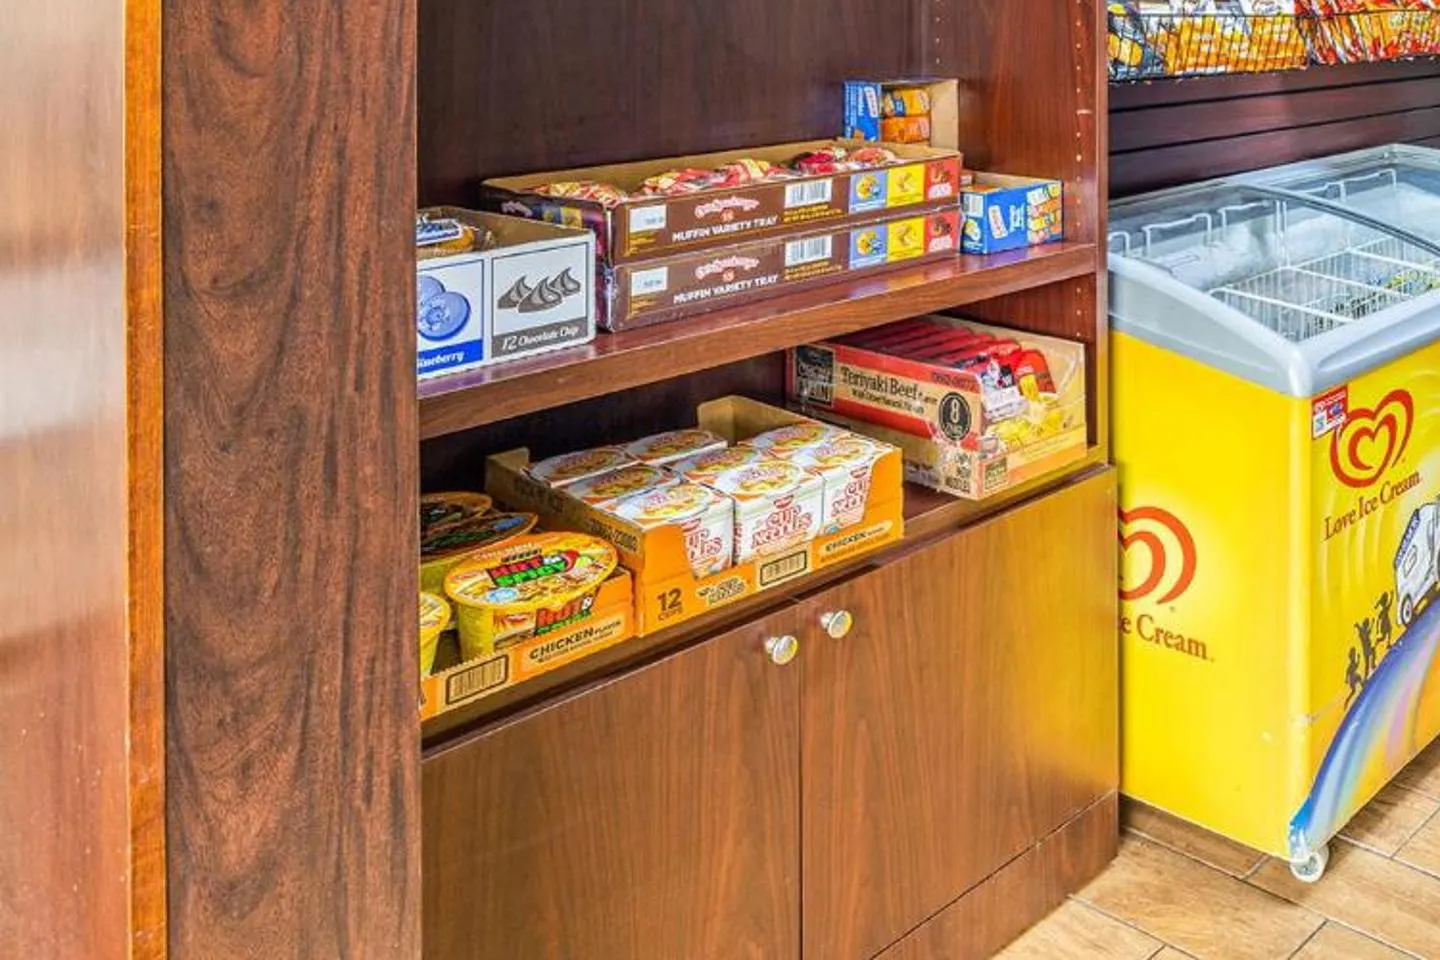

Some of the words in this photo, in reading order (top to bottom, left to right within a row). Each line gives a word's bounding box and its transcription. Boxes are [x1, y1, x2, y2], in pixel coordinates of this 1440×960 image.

[672, 228, 709, 242] MUFFIN
[711, 220, 751, 235] VARIETY
[753, 215, 779, 227] TRAY
[673, 287, 711, 303] MUFFIN
[712, 279, 752, 294] VARIETY
[754, 274, 779, 286] TRAY
[502, 335, 518, 352] 12
[518, 330, 558, 346] Chocolate
[559, 325, 580, 339] Chip
[840, 365, 889, 392] Teriyaki
[889, 374, 918, 399] Beef
[952, 398, 961, 424] 8
[1323, 515, 1357, 542] Love
[1357, 493, 1379, 520] Ice
[1379, 470, 1421, 505] Cream
[656, 587, 682, 611] 12
[529, 627, 594, 660] CHICKEN
[1136, 613, 1208, 661] Cream
